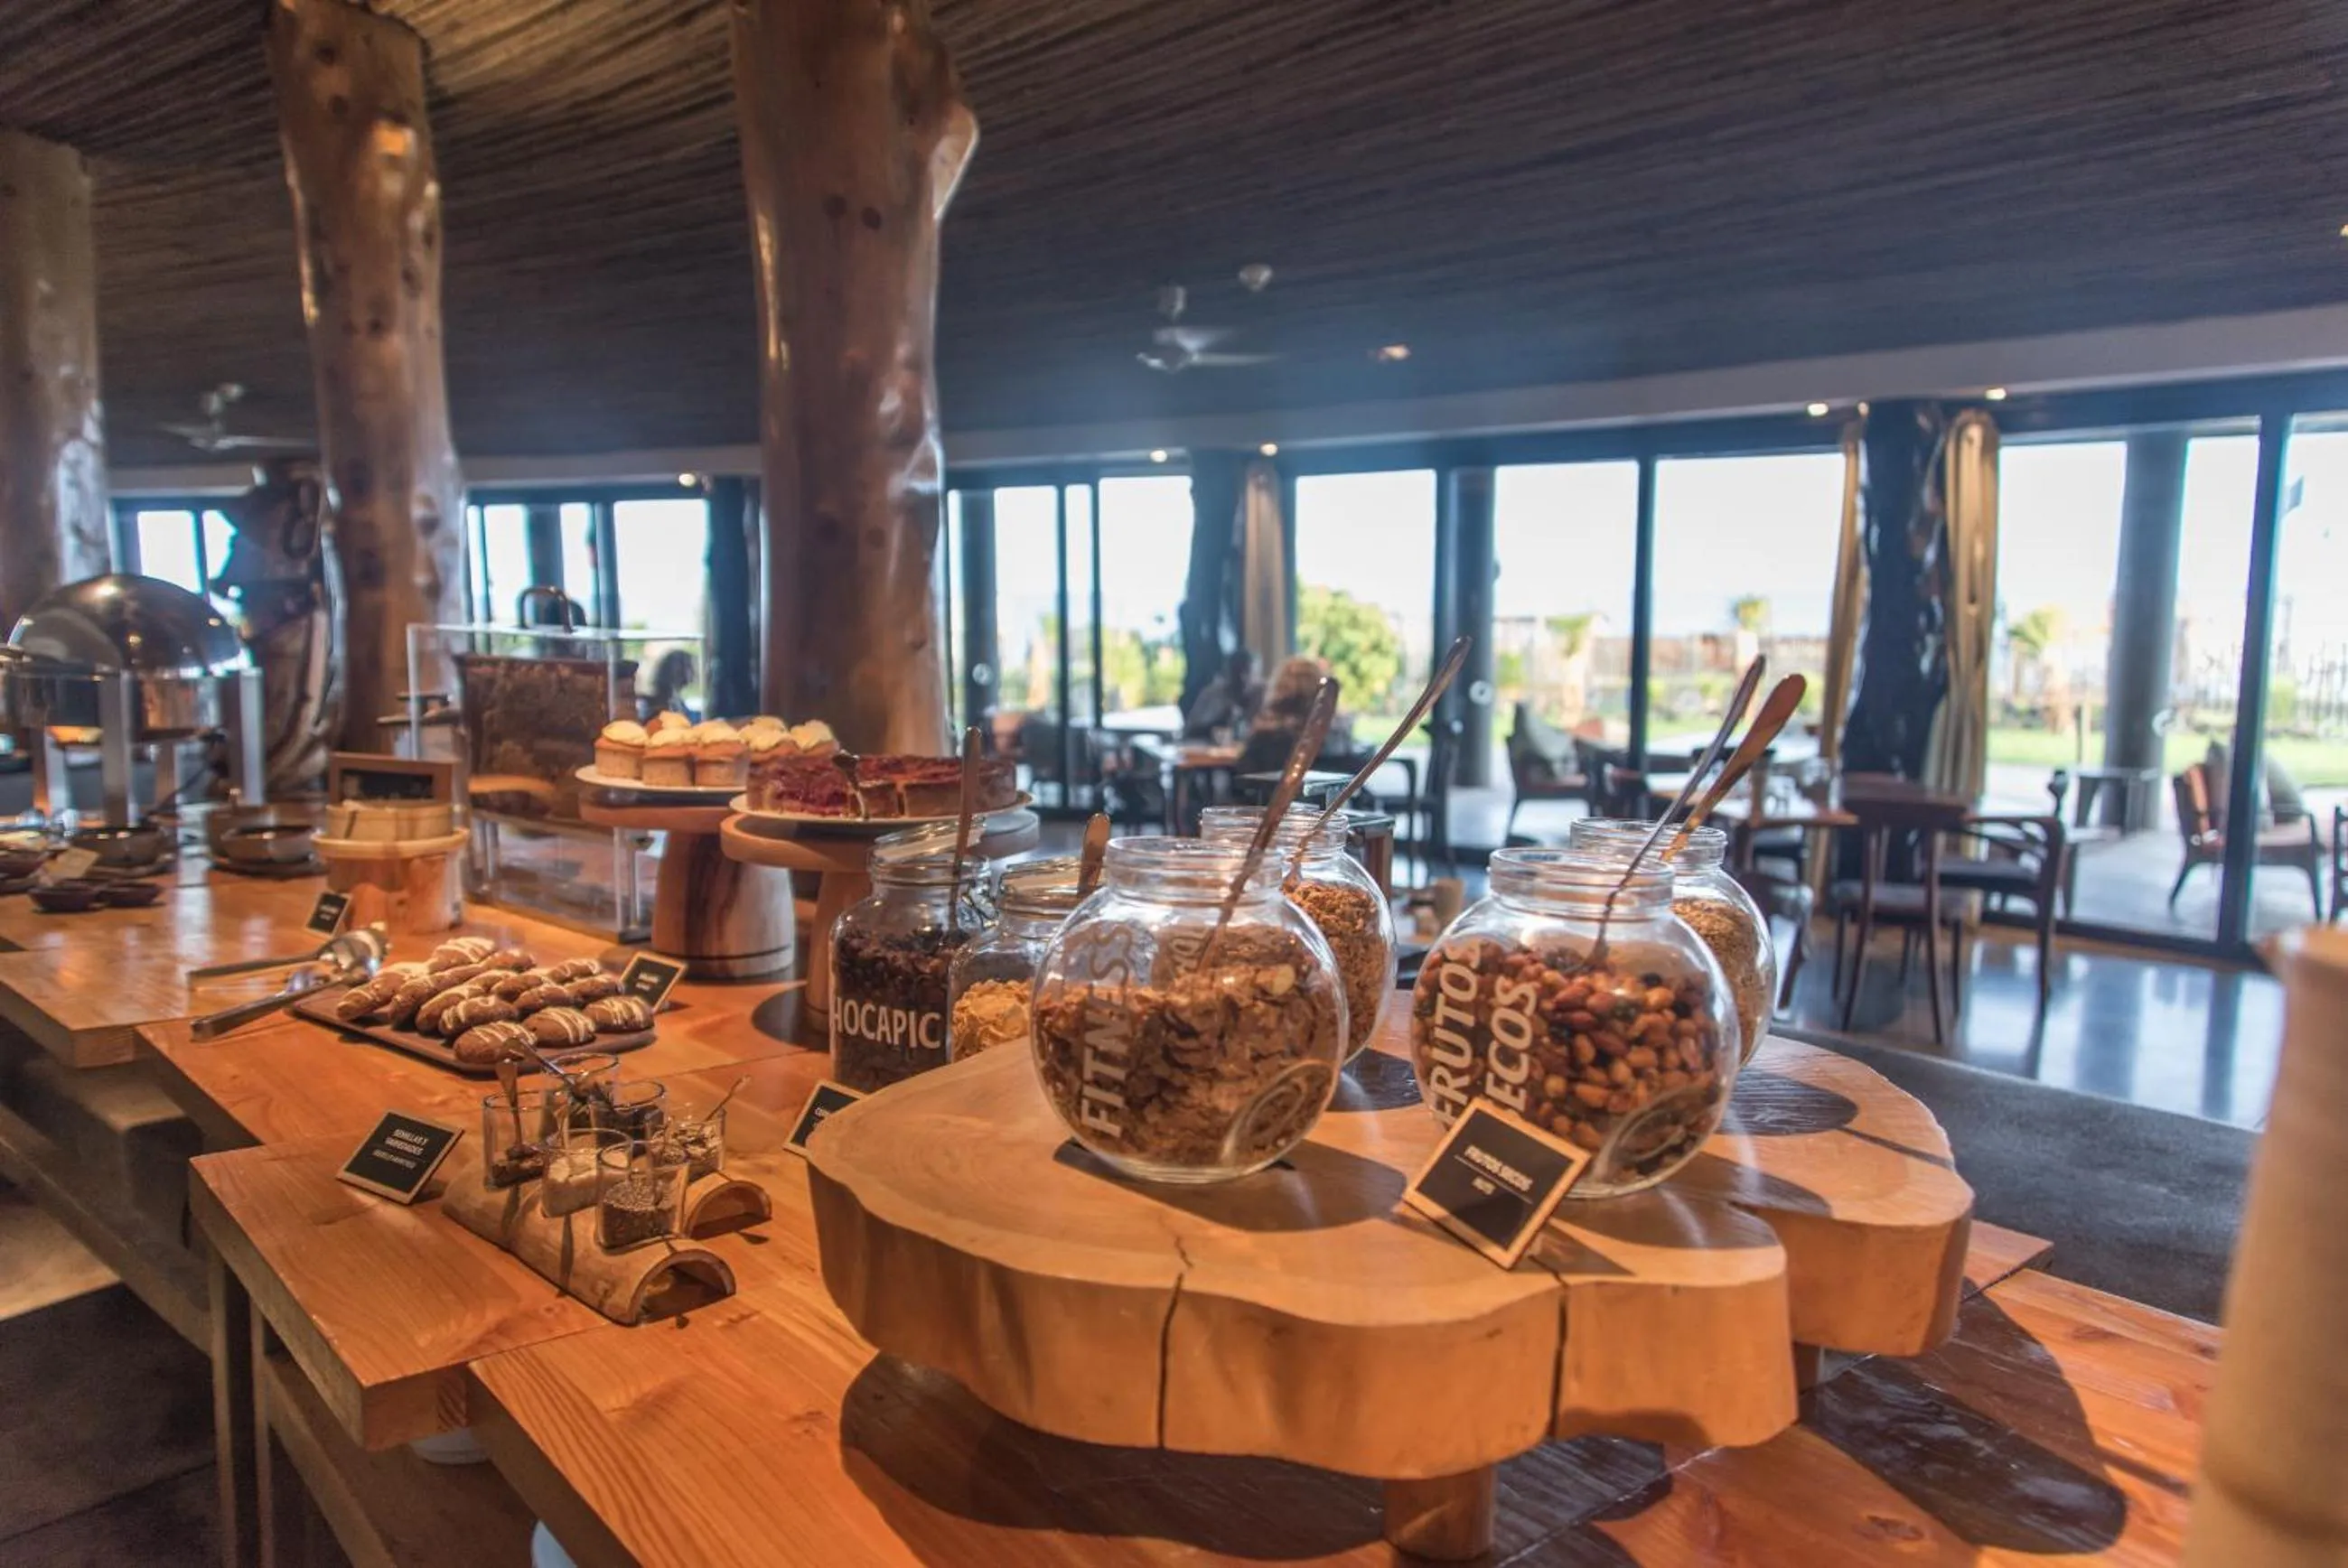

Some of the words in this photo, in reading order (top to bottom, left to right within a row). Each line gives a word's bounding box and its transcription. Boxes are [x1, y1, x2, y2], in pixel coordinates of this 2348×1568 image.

[1080, 922, 1132, 1138] FITNESS
[1430, 938, 1482, 1125] FRUTOS
[1485, 975, 1540, 1114] ECOS
